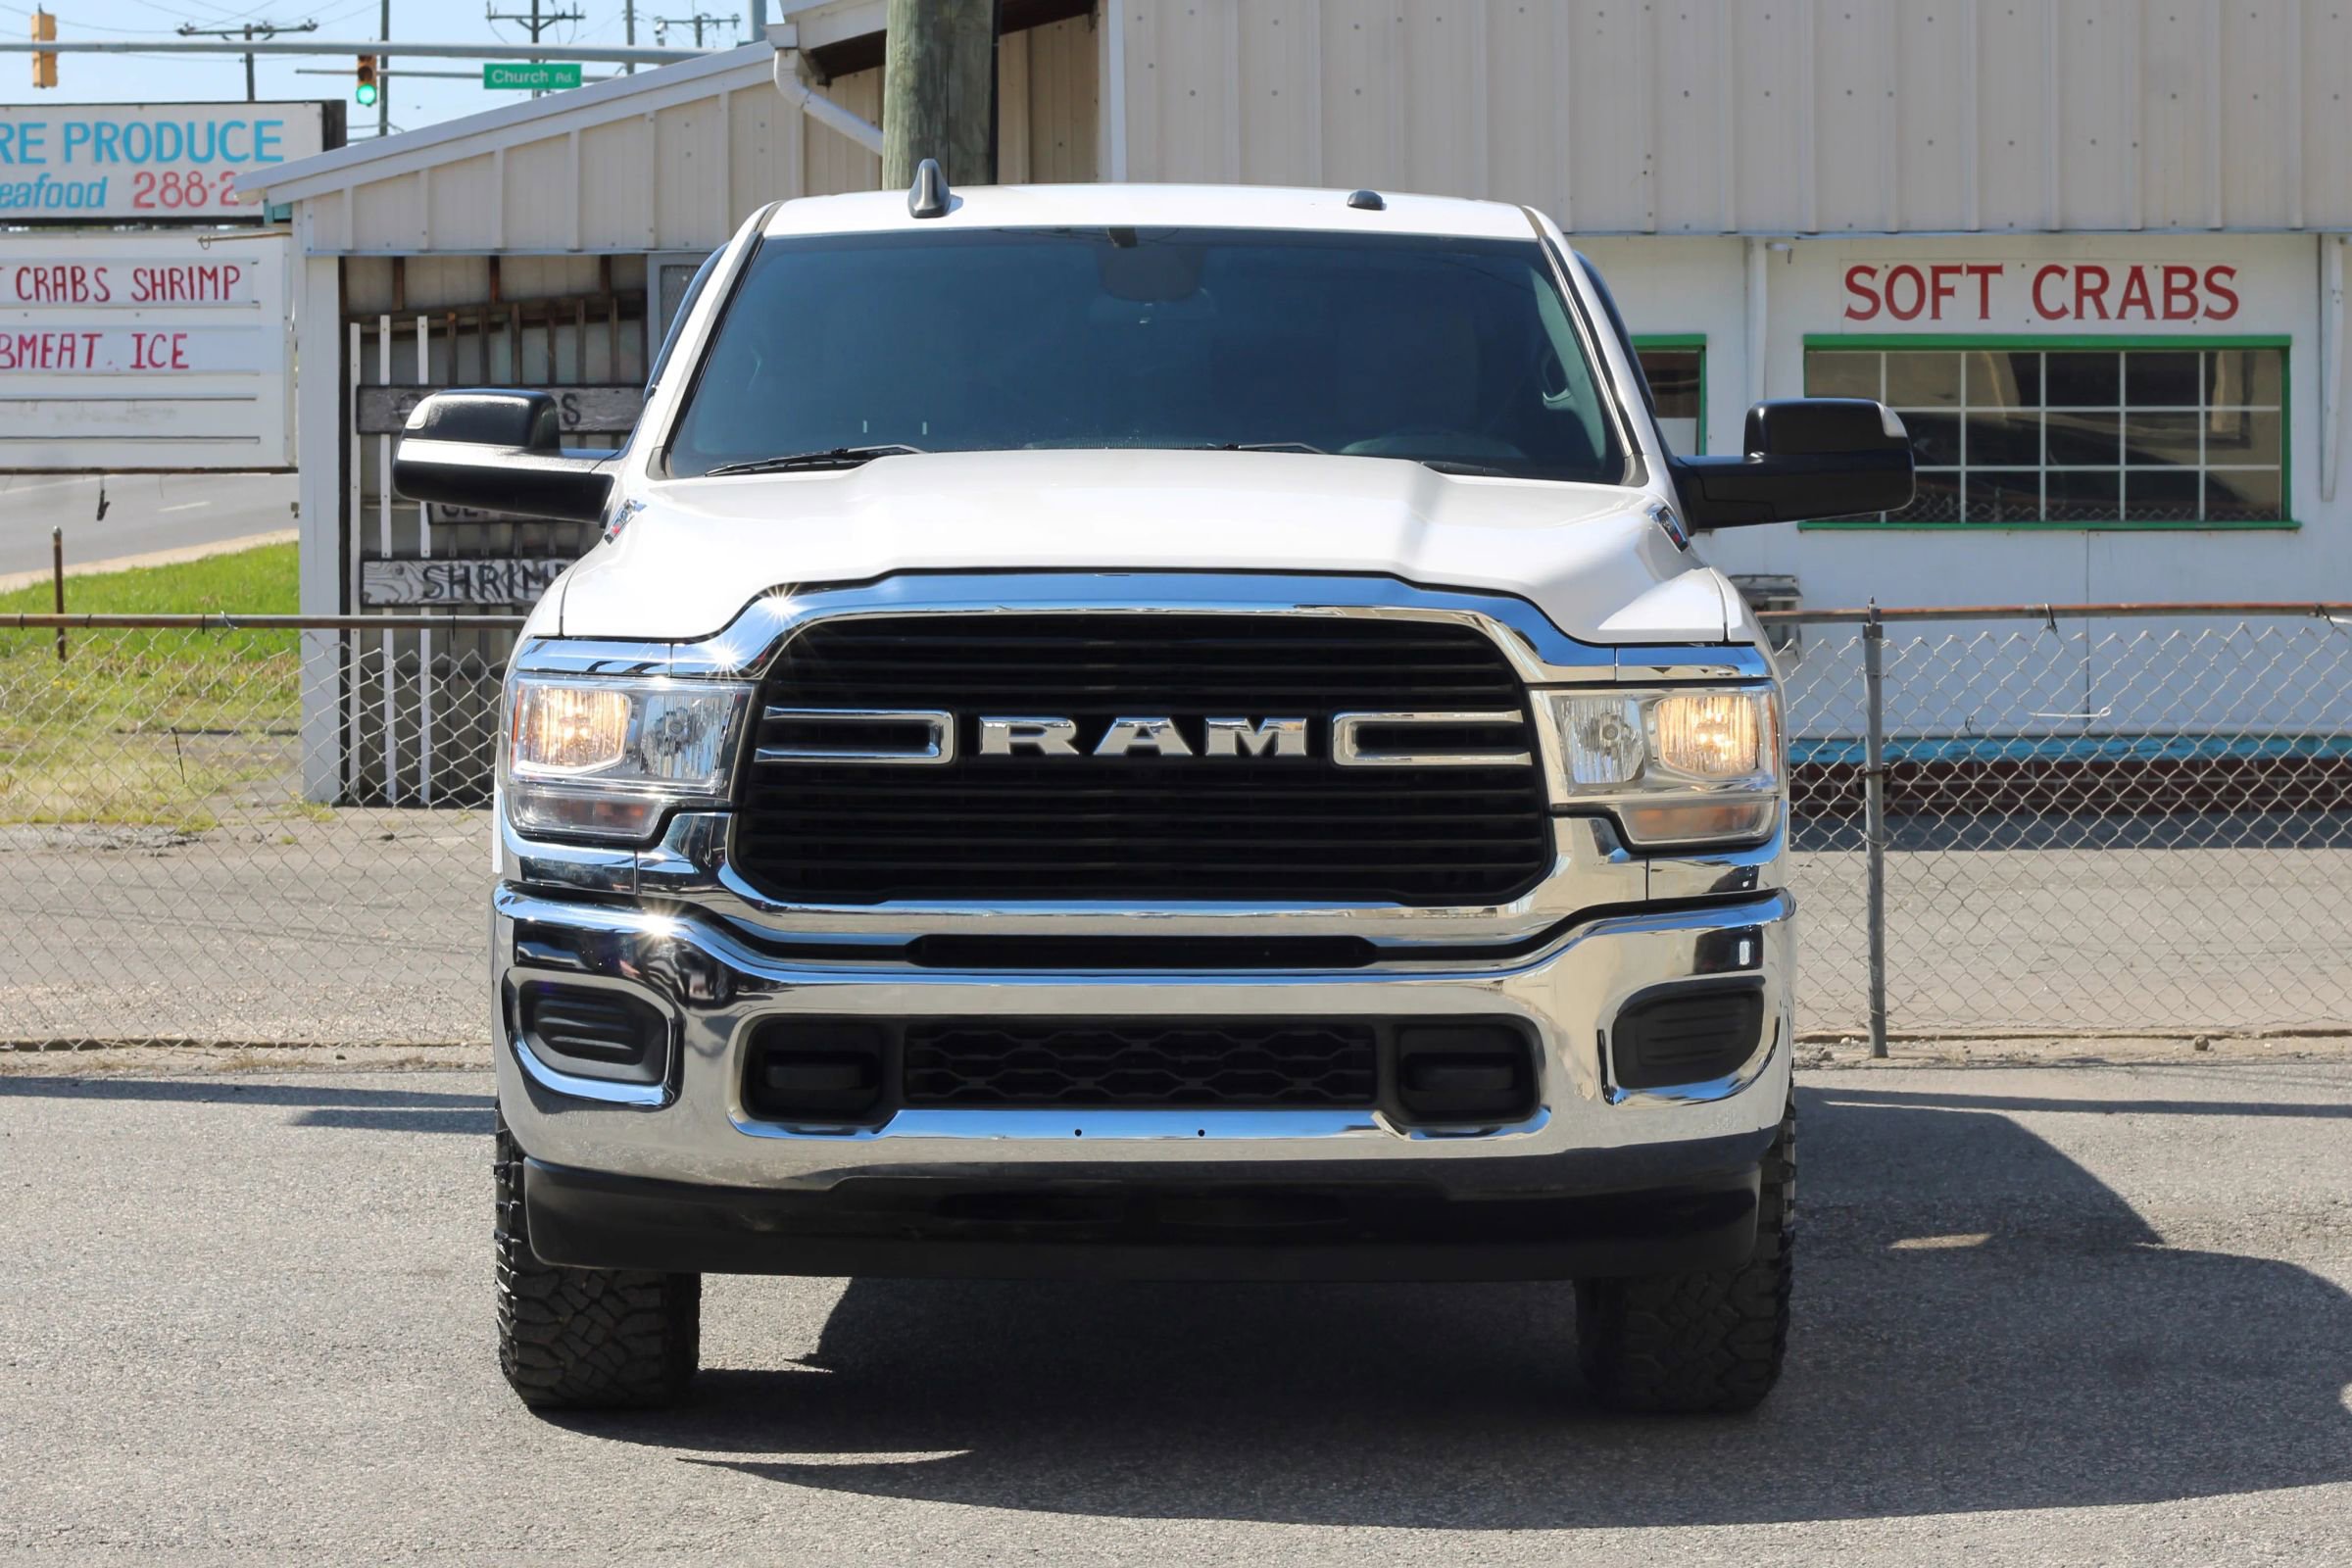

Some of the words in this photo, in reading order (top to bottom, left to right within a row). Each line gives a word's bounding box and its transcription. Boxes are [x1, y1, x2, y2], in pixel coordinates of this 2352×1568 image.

[492, 70, 549, 83] Church
[64, 121, 284, 164] PRODUCE
[0, 172, 108, 209] eafood
[16, 266, 111, 303] CRABS
[131, 266, 240, 302] SHRIMP
[1844, 264, 2004, 320] SOFT
[2032, 264, 2240, 320] CRABS
[129, 333, 189, 369] ICE
[979, 716, 1308, 757] RAM
